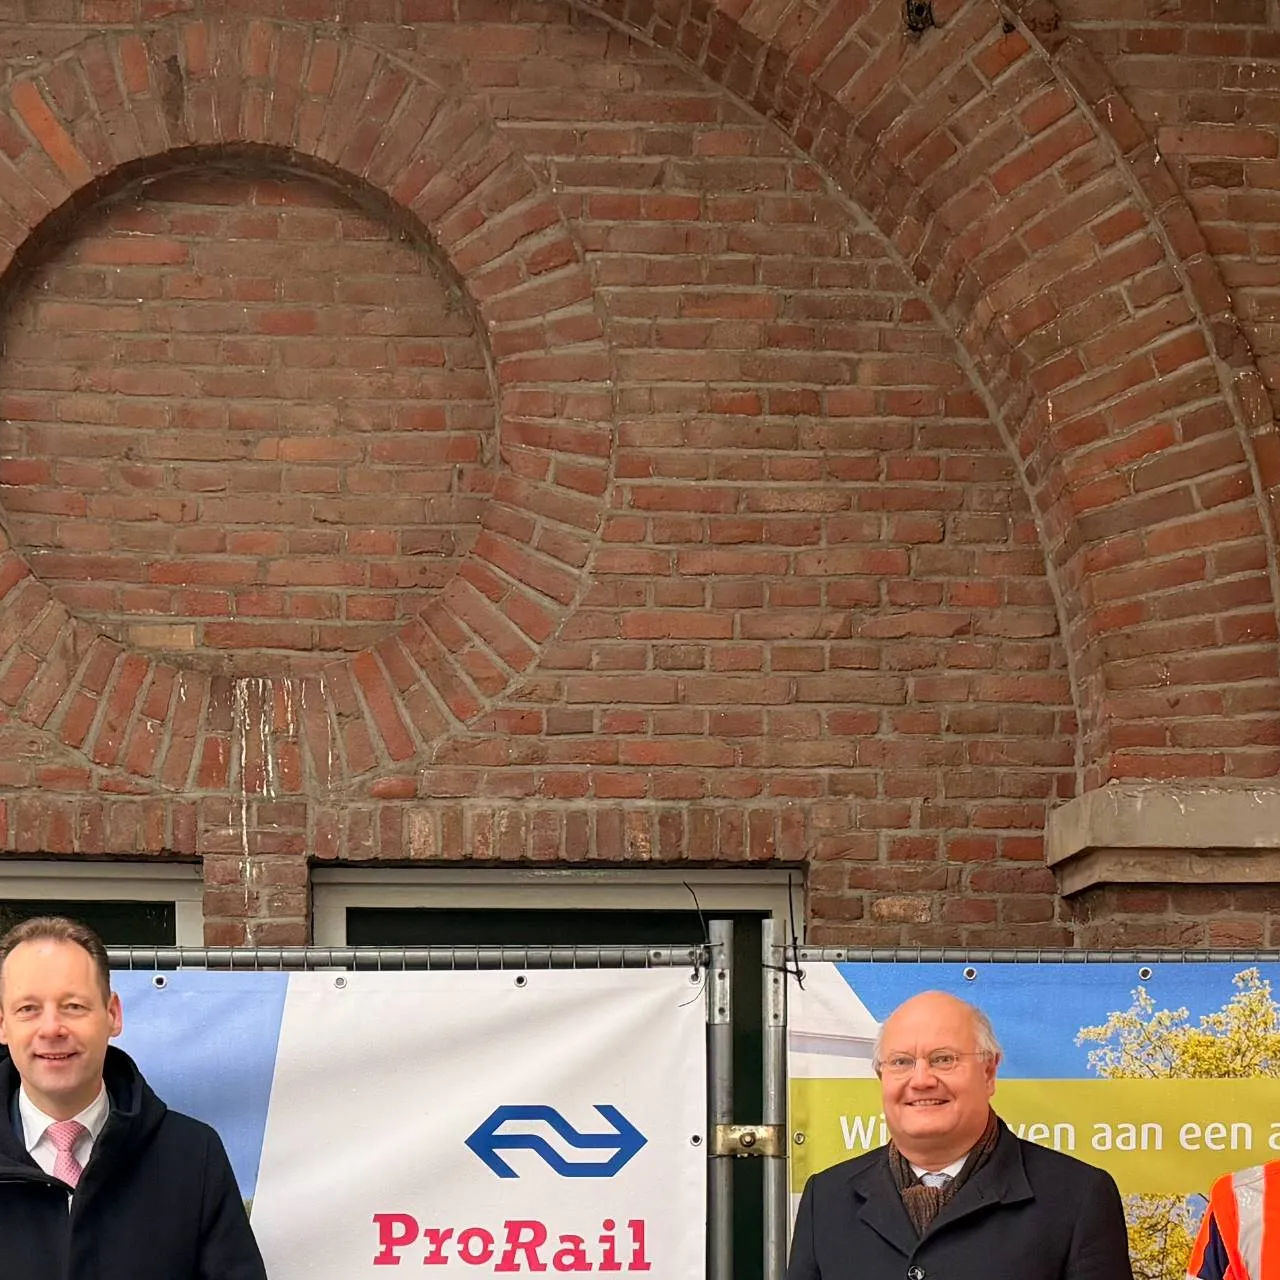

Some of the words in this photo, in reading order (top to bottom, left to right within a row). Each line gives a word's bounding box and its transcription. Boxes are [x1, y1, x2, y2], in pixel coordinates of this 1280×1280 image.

[1091, 1121, 1163, 1151] aan
[1179, 1121, 1252, 1151] een
[372, 1213, 652, 1272] ProRail
